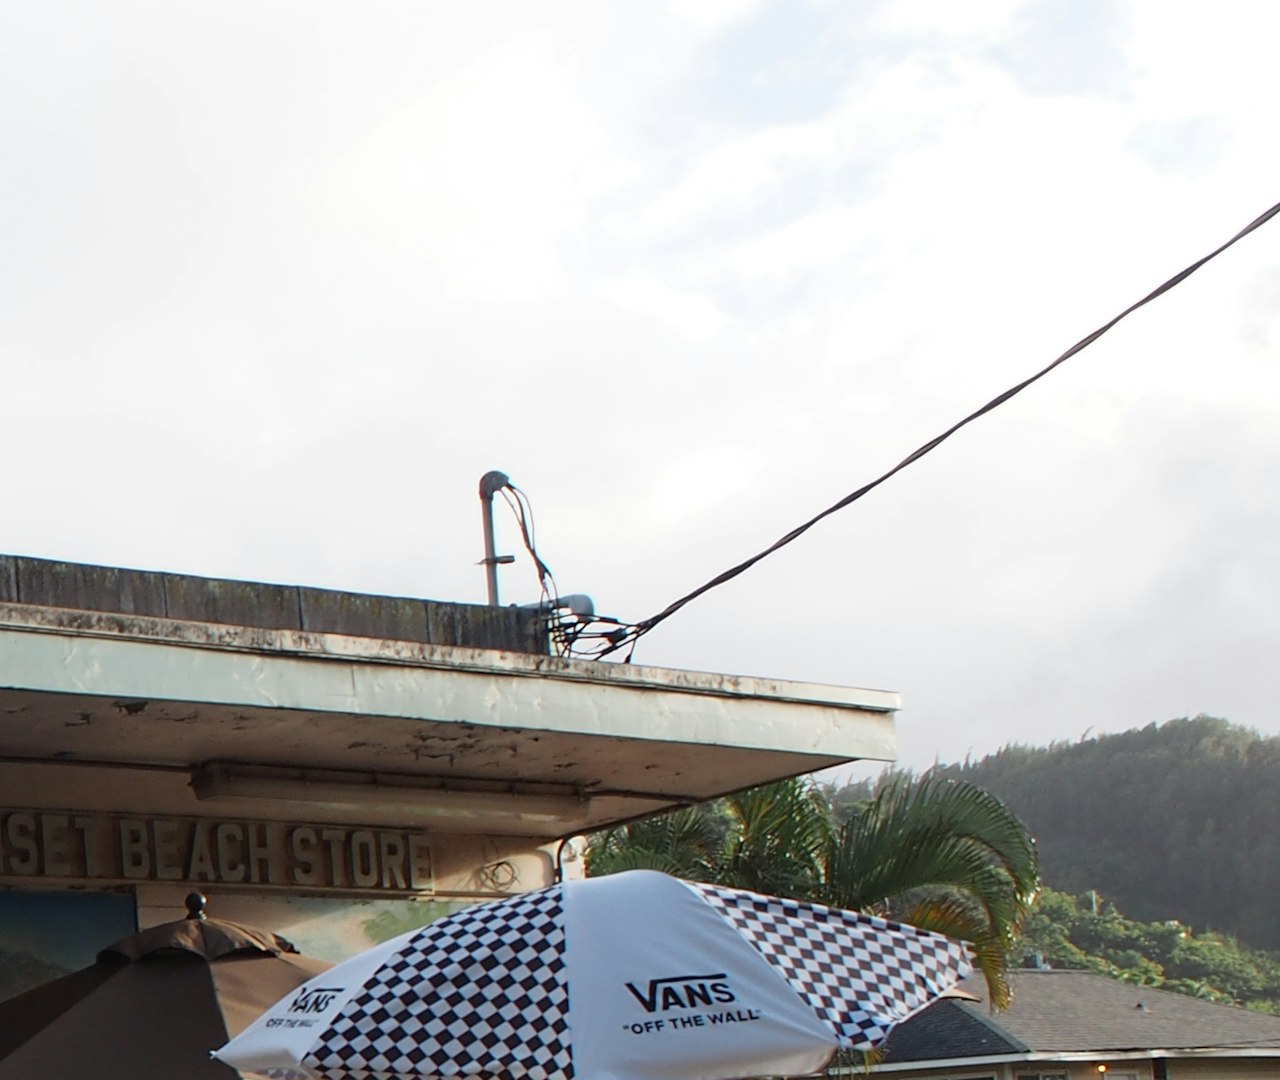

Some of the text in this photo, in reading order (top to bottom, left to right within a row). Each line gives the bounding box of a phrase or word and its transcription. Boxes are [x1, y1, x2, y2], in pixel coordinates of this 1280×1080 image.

[120, 818, 274, 884] BEACH
[290, 825, 433, 890] STORE
[288, 987, 345, 1013] VANS
[624, 973, 735, 1012] VANS
[669, 1015, 704, 1029] THE
